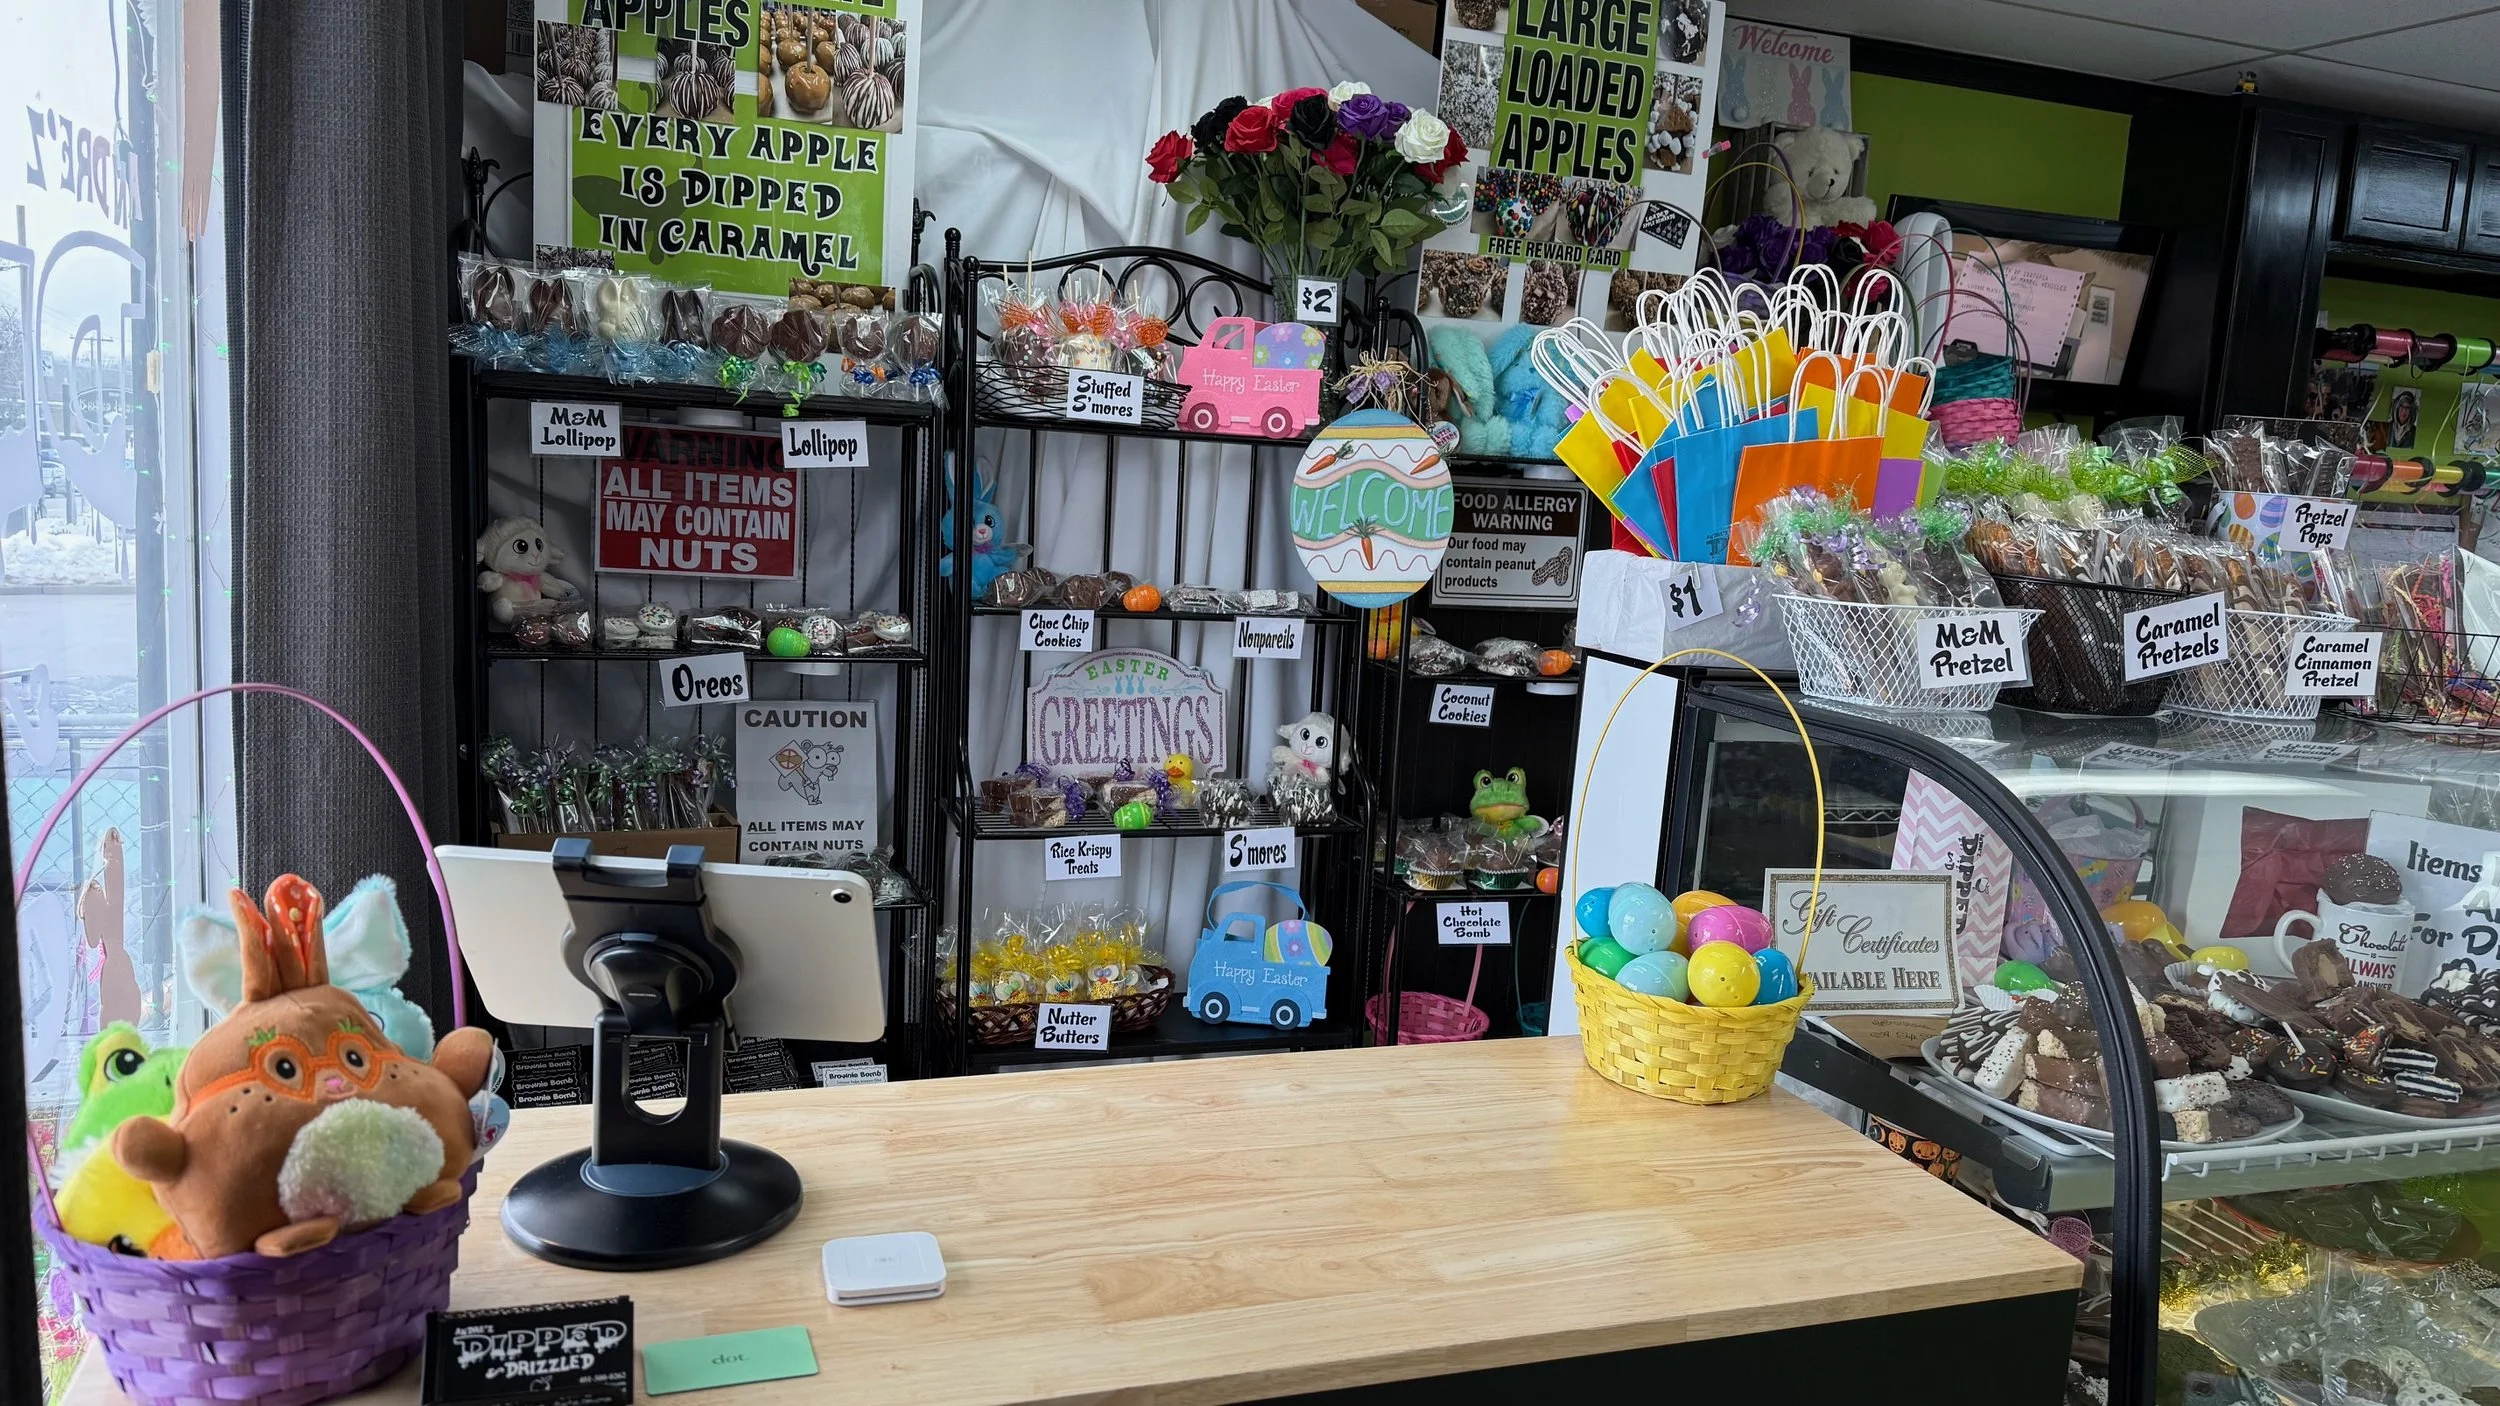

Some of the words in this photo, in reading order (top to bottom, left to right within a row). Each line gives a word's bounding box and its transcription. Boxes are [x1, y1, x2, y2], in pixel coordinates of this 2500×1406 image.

[581, 0, 751, 48] APPLES
[1515, 0, 1652, 57] LARGE
[1732, 23, 1834, 64] Welcome
[1506, 44, 1647, 121] LOADED
[579, 107, 740, 160] EVERY
[748, 124, 880, 173] APPLE
[1500, 112, 1638, 184] APPLES
[621, 166, 666, 206] IS
[679, 169, 843, 221] DIPPED
[600, 214, 648, 254] IN
[660, 218, 859, 277] CARAMEL
[1488, 237, 1521, 257] FREE
[1525, 240, 1583, 264] REWARD
[1586, 248, 1622, 267] CARD
[1302, 286, 1332, 313] $2
[1077, 375, 1131, 397] Stuffed
[1202, 368, 1245, 393] Happy
[1253, 374, 1299, 393] Easter
[550, 407, 607, 428] M&M
[1072, 395, 1133, 418] S'mores
[541, 427, 616, 450] Lollipop
[788, 428, 857, 461] Lollipop
[604, 467, 672, 500] ALL
[685, 471, 793, 508] ITEMS
[1292, 470, 1452, 538] WELCOME
[1503, 494, 1577, 514] ALLERGY
[2295, 503, 2349, 527] Pretzel
[606, 503, 666, 534] MAY
[675, 505, 790, 541] CONTAIN
[1472, 512, 1553, 531] WARNING
[1448, 537, 1469, 549] Our
[1472, 537, 1498, 550] food
[1502, 541, 1526, 554] may
[2299, 525, 2333, 548] Pops
[640, 538, 758, 572] NUTS
[1446, 557, 1491, 571] contain
[1495, 559, 1536, 573] peanut
[1444, 575, 1498, 588] products
[1669, 575, 1703, 618] $1
[1028, 613, 1060, 632] Choc
[1062, 614, 1089, 634] Chip
[1934, 620, 2005, 648] M&M
[2136, 602, 2220, 644] Caramel
[1034, 631, 1082, 648] Cookies
[1238, 625, 1294, 654] Nonpareils
[2137, 632, 2220, 670] Pretzels
[2303, 635, 2369, 653] Caramel
[1085, 659, 1169, 682] EASTER
[1930, 648, 2014, 678] Pretzel
[2294, 653, 2371, 671] Cinnamon
[672, 663, 743, 702] Oreos
[2302, 671, 2359, 687] Pretzel
[1441, 687, 1491, 706] Coconut
[744, 708, 867, 728] CAUTION
[1438, 704, 1487, 723] Cookies
[1039, 695, 1216, 766] GREETINGS
[748, 821, 776, 834] ALL
[781, 821, 828, 833] ITEMS
[832, 820, 864, 832] MAY
[748, 839, 819, 851] CONTAIN
[823, 839, 864, 851] NUTS
[1051, 842, 1075, 859] Rice
[1078, 840, 1112, 861] Krispy
[1229, 834, 1287, 867] S'mores
[1064, 858, 1099, 876] Treats
[2407, 840, 2483, 883] Items
[1443, 917, 1501, 928] Chocolate
[1460, 905, 1483, 918] Hot
[1782, 889, 1837, 936] Gift
[1453, 927, 1491, 938] Bomb
[1837, 914, 1939, 960] Certificates
[1214, 961, 1255, 985] Happy
[1263, 968, 1308, 987] Easter
[1808, 971, 1887, 990] AILABLE
[1892, 967, 1941, 989] HERE
[1048, 1008, 1097, 1027] Nutter
[1040, 1025, 1099, 1046] Butters
[516, 1081, 549, 1091] Brownie
[550, 1077, 574, 1086] Bomb
[829, 1072, 858, 1080] Brownie
[860, 1070, 882, 1078] Bomb
[518, 1094, 551, 1103] Brownie
[553, 1091, 577, 1100] Bomb
[452, 1320, 627, 1370] DIPPED
[504, 1353, 595, 1379] DRIZZLED
